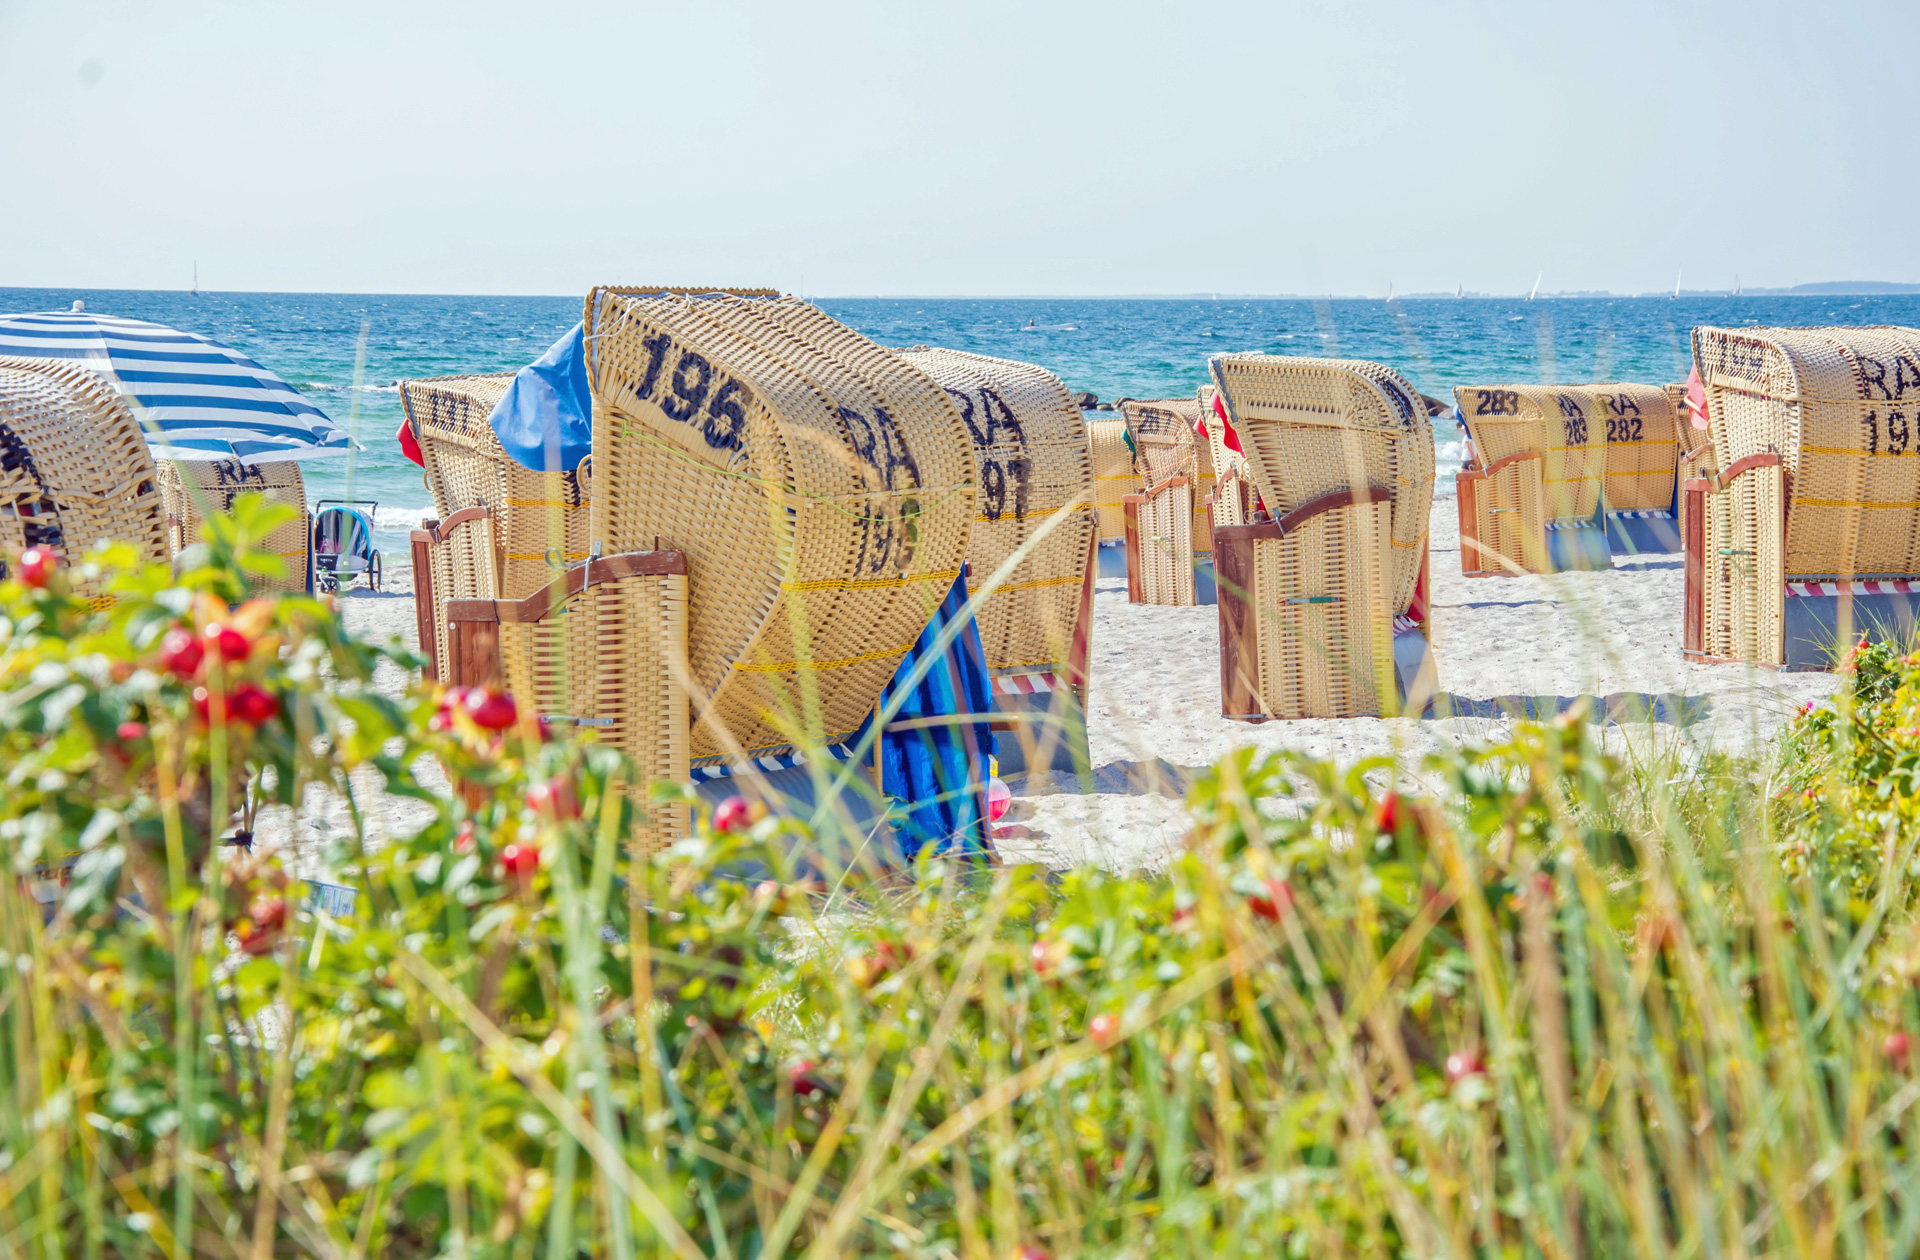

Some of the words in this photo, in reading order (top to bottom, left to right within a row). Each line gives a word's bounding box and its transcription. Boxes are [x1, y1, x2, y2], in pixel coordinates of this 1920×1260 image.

[636, 333, 754, 452] 196
[1477, 389, 1519, 416] 283
[1559, 393, 1584, 417] RA
[1598, 393, 1641, 416] RA
[1138, 406, 1174, 435] 287
[1566, 417, 1588, 447] 283
[1605, 418, 1643, 442] 282
[1861, 410, 1920, 455] 19
[838, 405, 921, 492] RA
